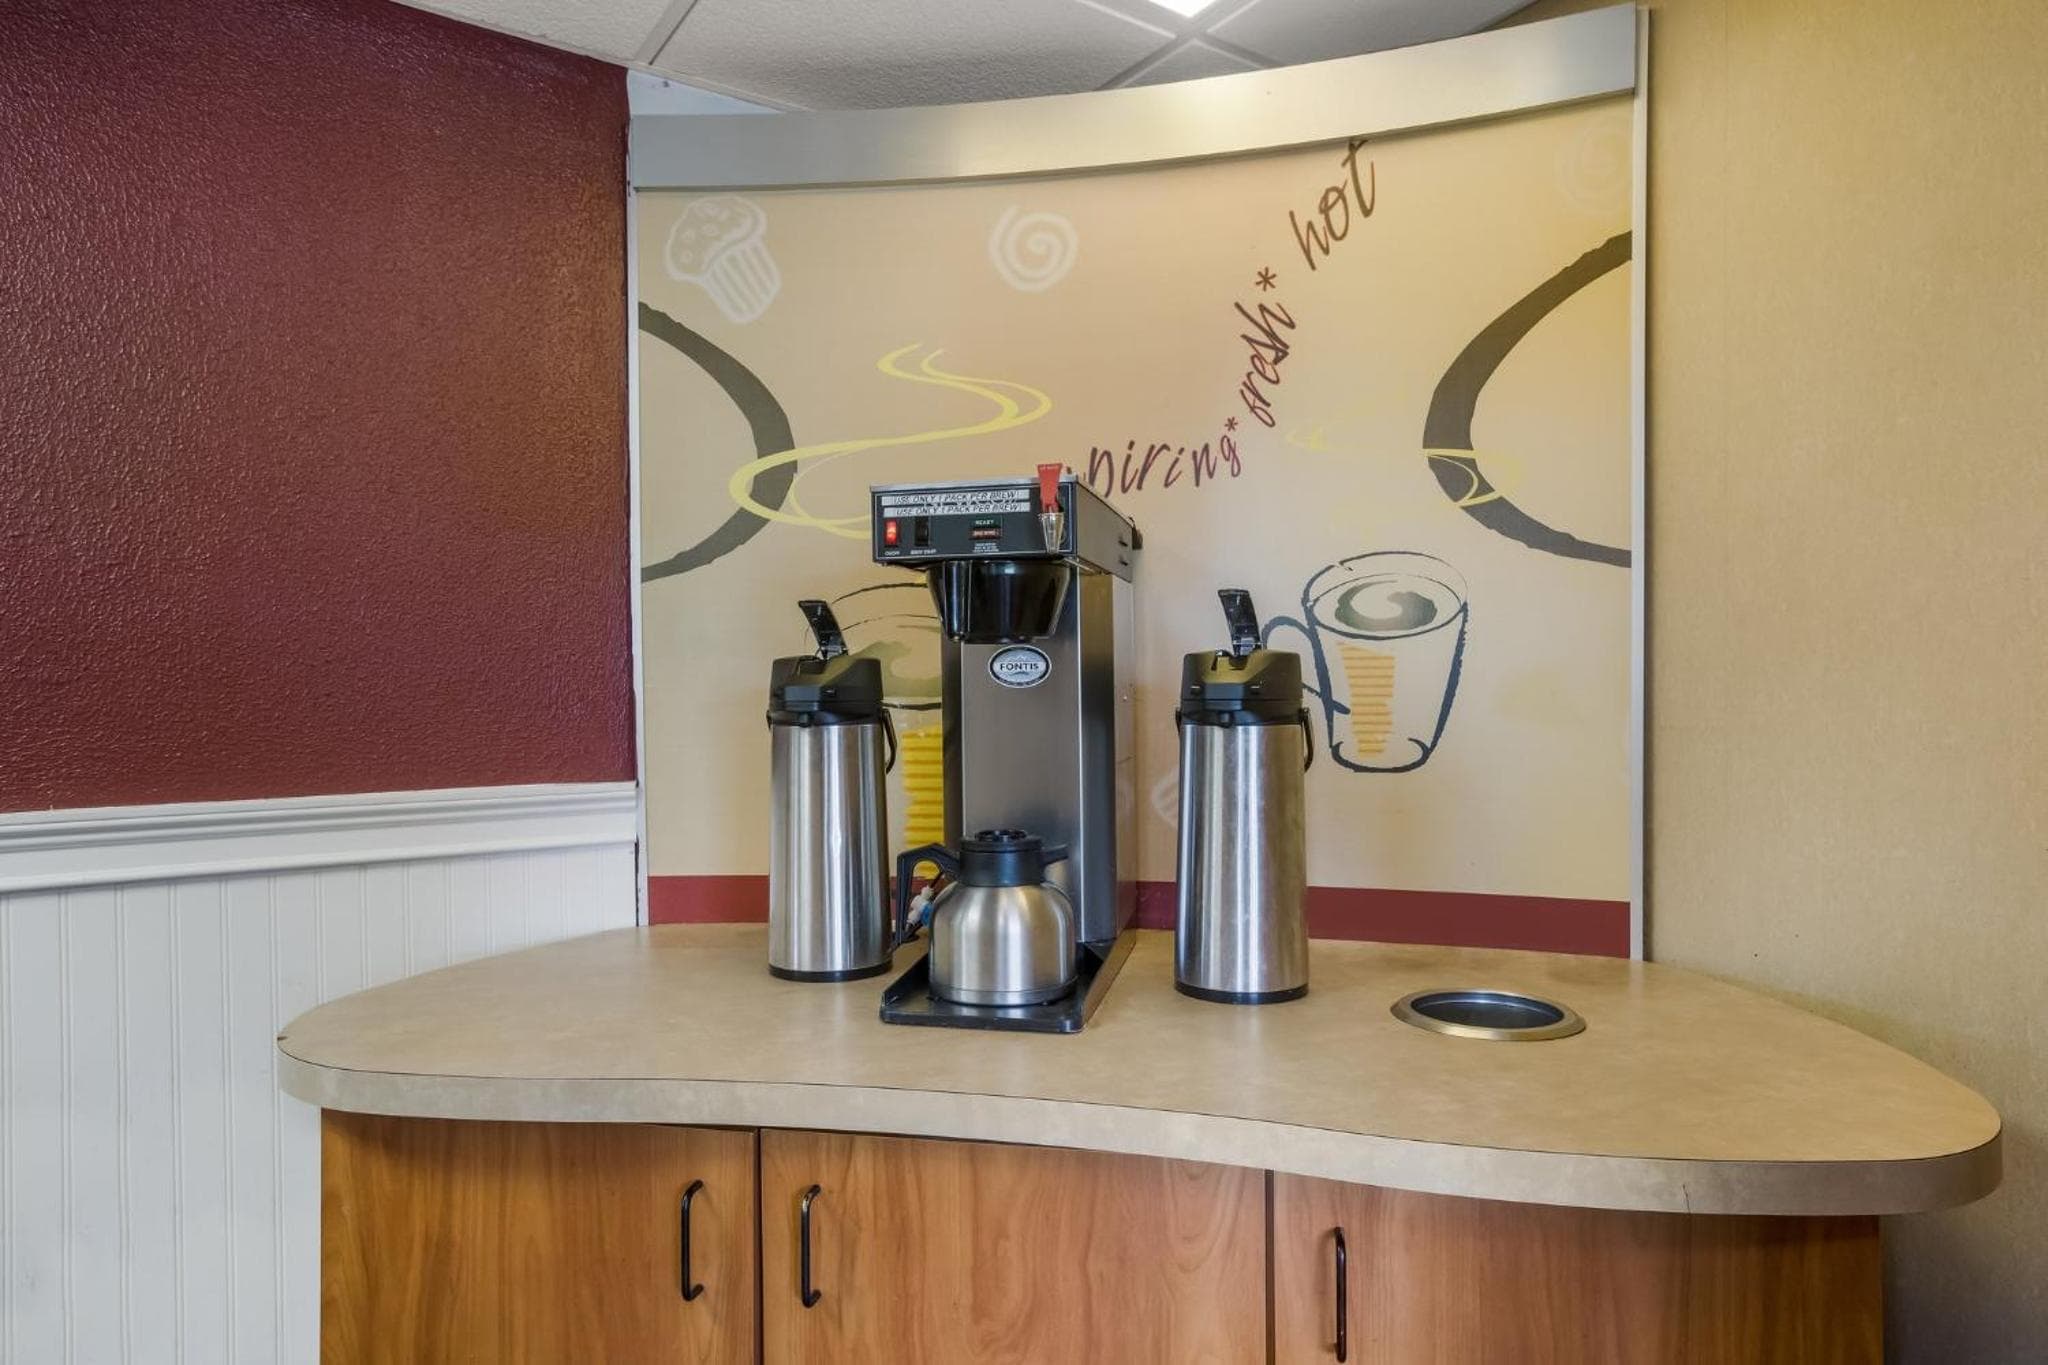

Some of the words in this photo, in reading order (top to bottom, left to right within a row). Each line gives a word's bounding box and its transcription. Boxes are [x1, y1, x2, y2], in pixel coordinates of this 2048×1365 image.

[1288, 138, 1377, 271] hot
[970, 491, 987, 501] PER
[973, 504, 991, 513] PER
